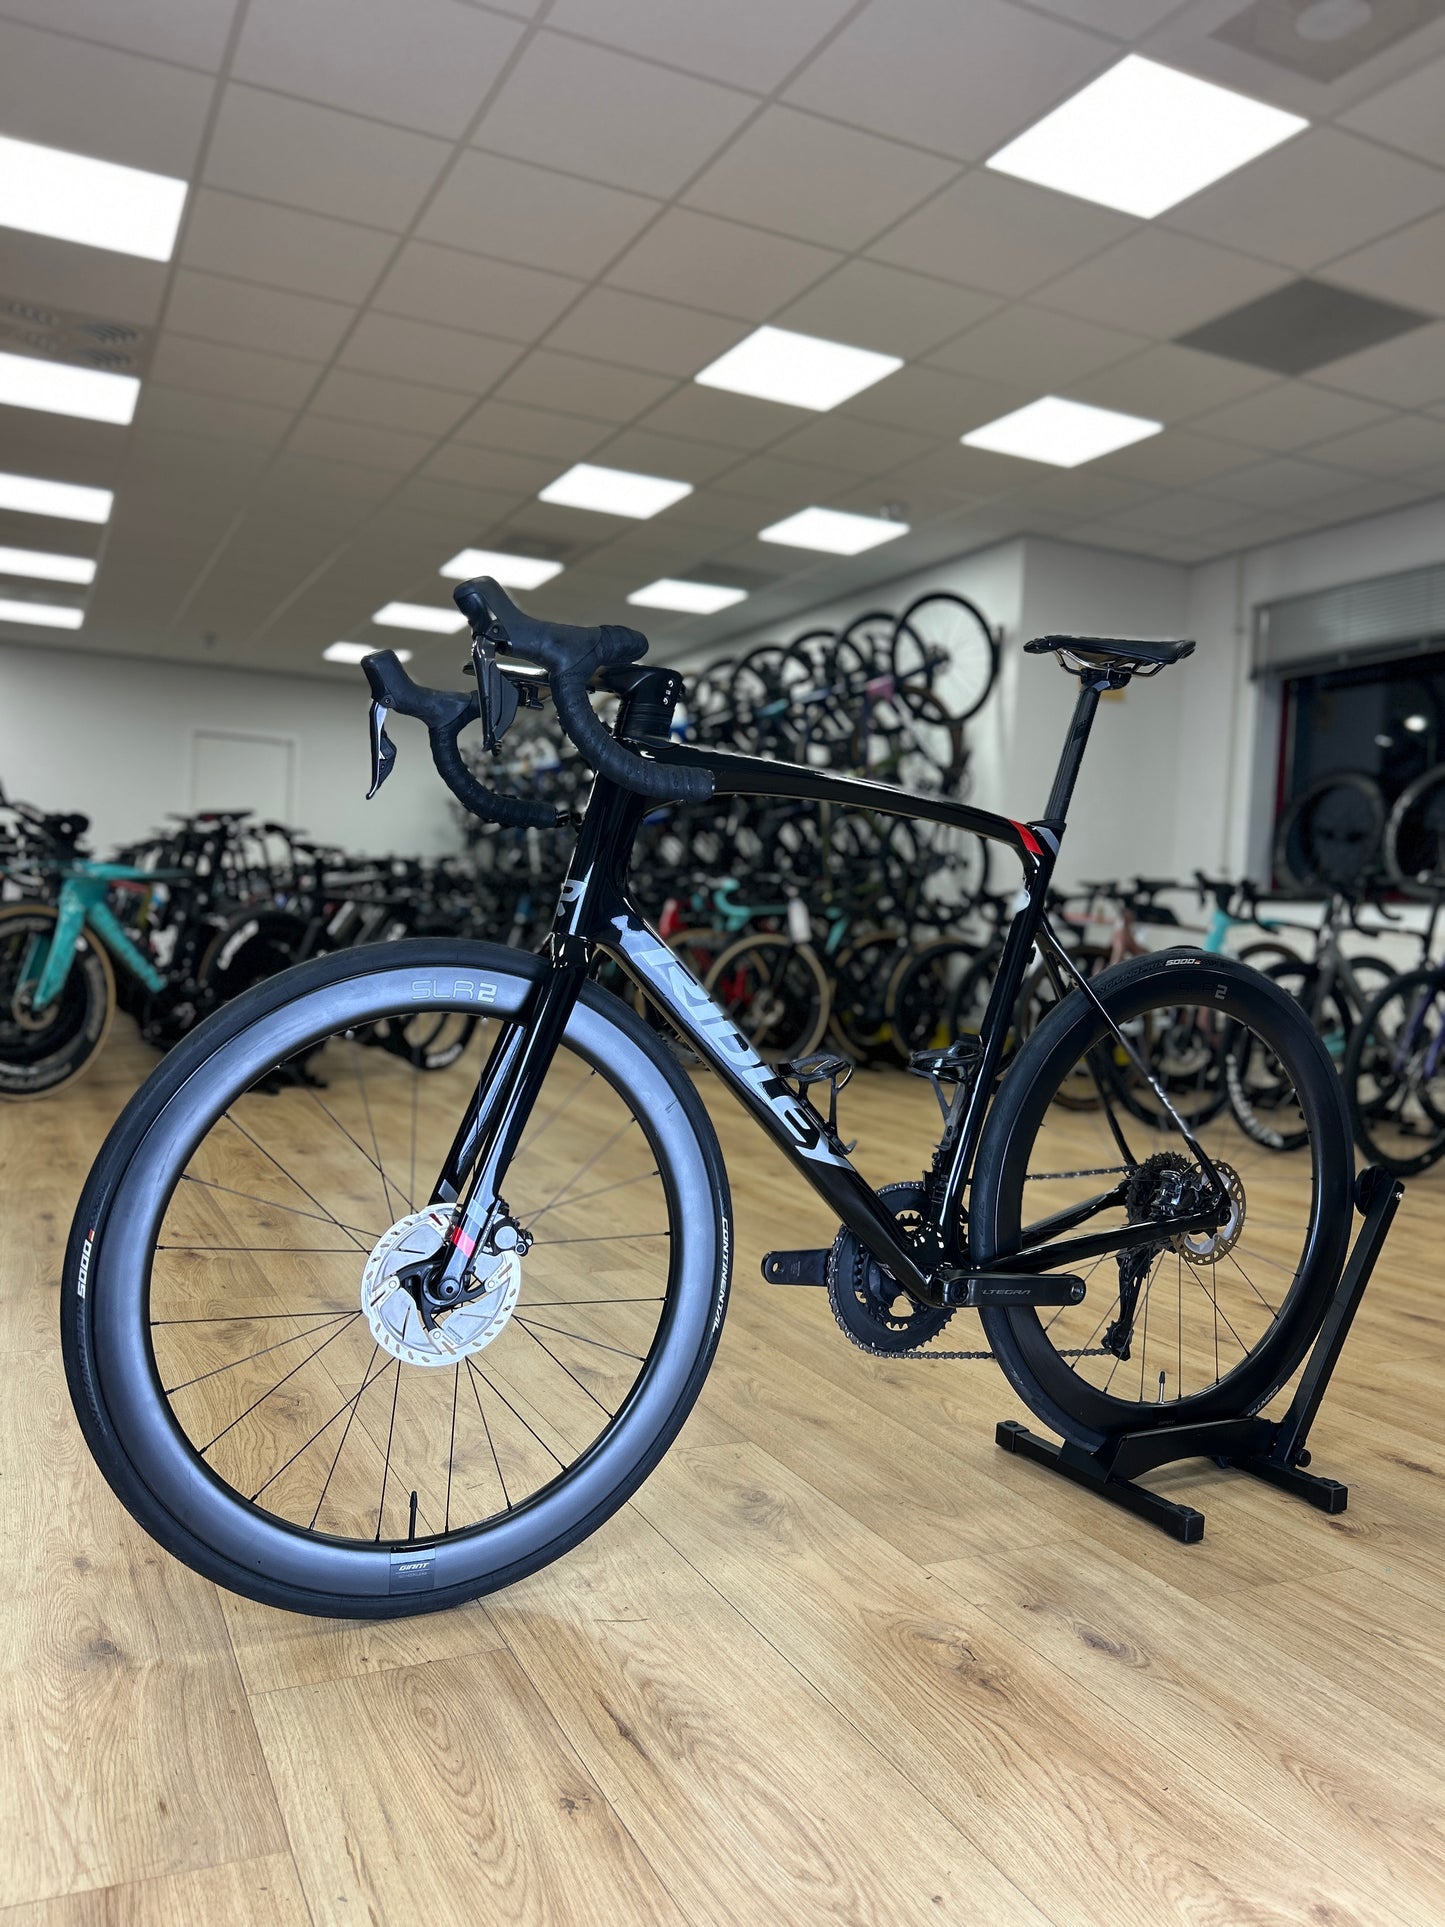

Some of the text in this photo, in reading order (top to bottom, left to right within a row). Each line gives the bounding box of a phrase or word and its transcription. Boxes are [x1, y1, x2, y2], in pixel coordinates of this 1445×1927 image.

[1165, 958, 1196, 967] 5000
[638, 948, 857, 1172] RIDLEY
[77, 1239, 92, 1299] 5000
[711, 1216, 730, 1334] CONTINENTAL
[981, 1288, 1032, 1296] LTEGRA
[398, 1561, 431, 1571] GIANT
